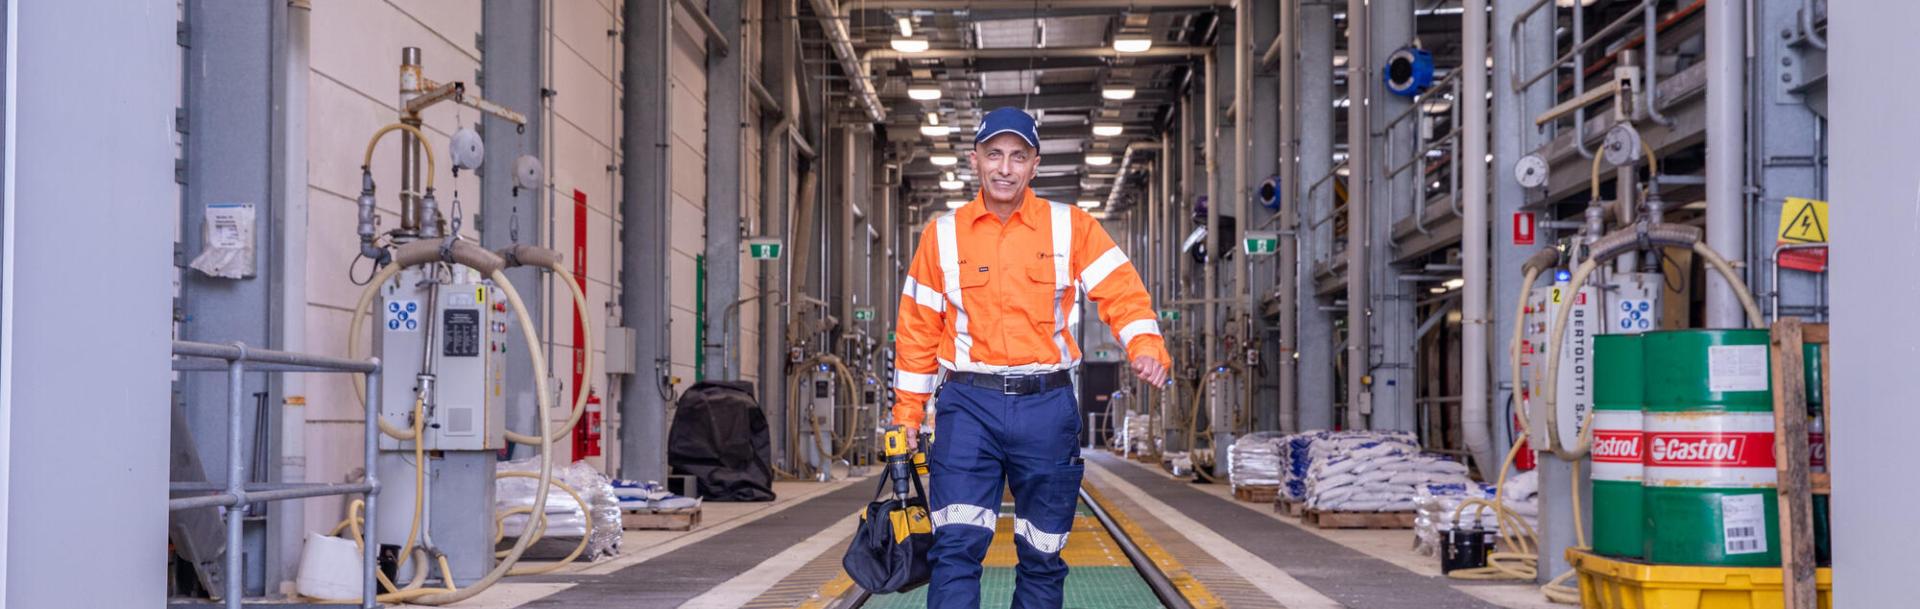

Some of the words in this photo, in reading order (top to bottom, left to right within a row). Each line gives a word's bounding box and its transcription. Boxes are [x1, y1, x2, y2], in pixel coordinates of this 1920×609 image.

[1553, 289, 1560, 302] 2
[1574, 309, 1584, 396] BERTOLOTTI
[1667, 438, 1736, 460] Castrol
